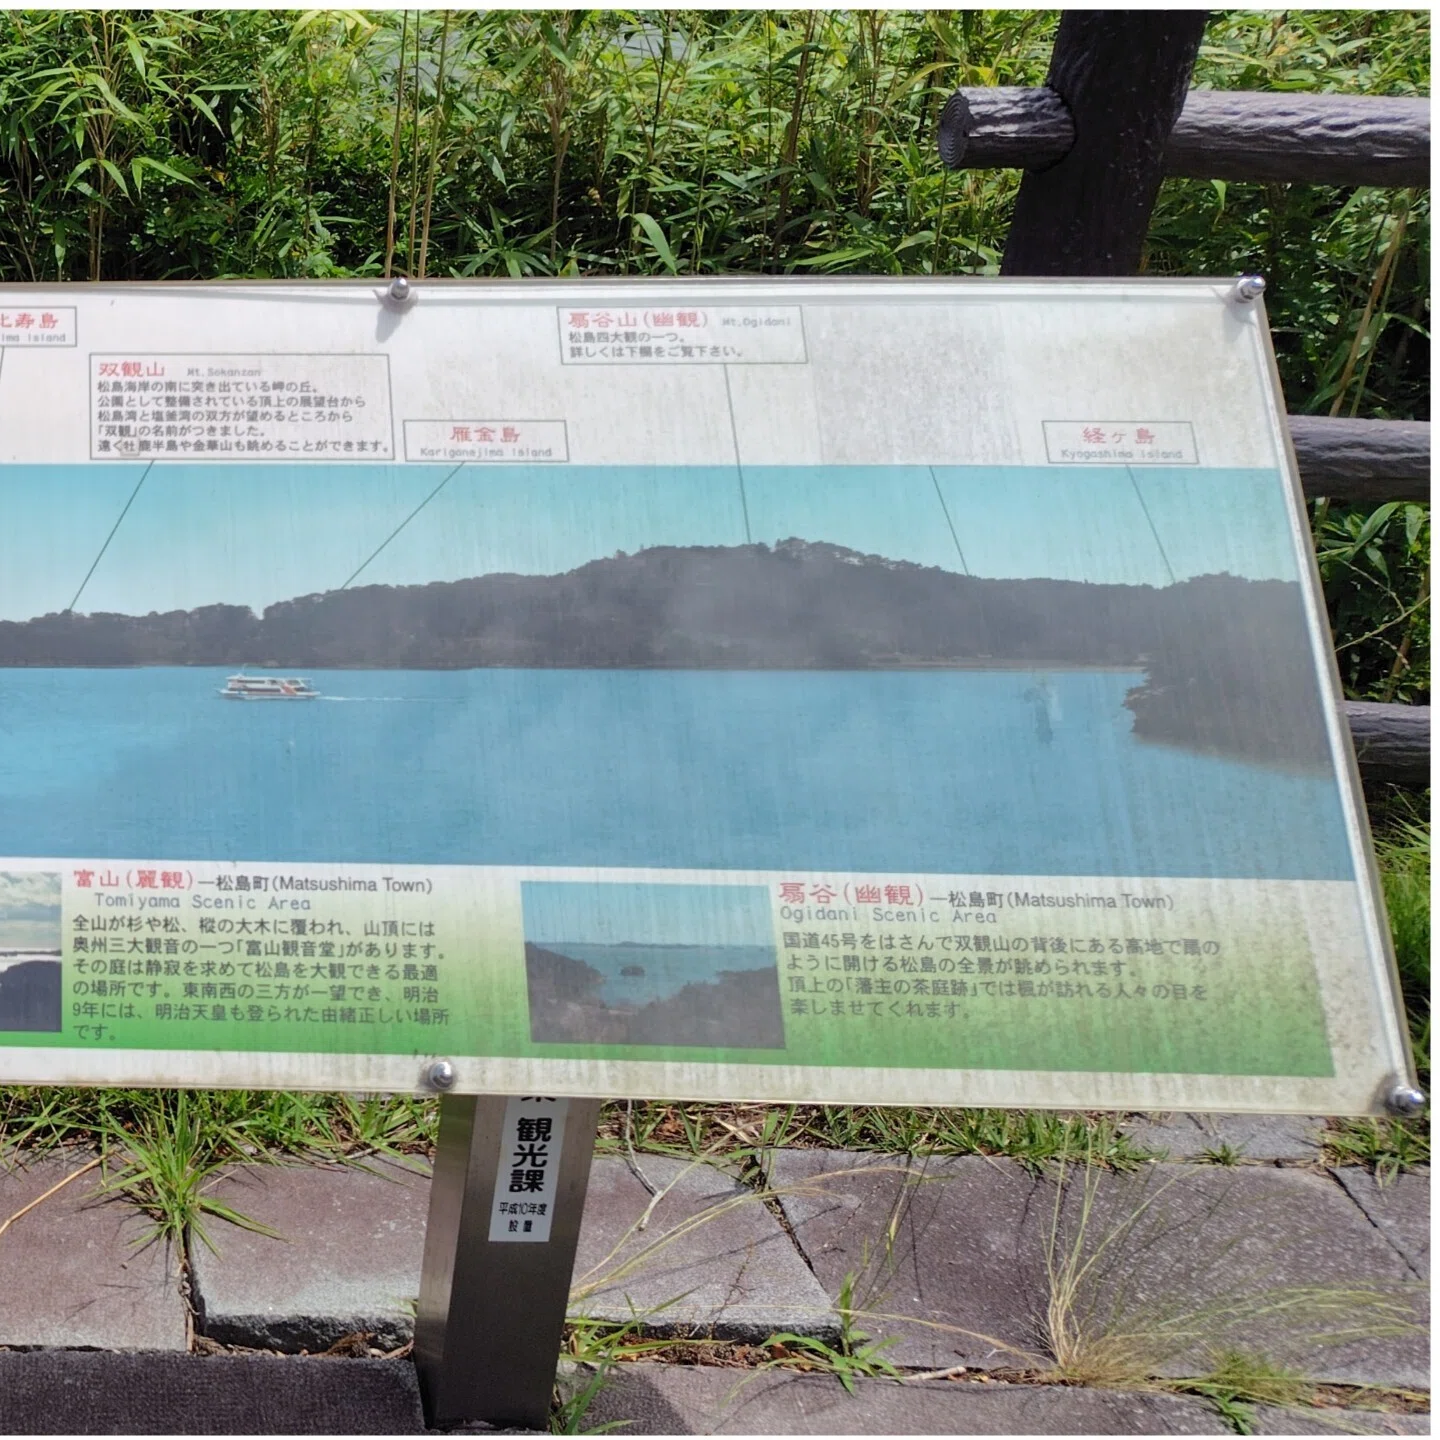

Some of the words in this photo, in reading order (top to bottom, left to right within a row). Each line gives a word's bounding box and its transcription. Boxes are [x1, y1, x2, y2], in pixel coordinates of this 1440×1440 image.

[569, 332, 686, 344] 松島四大観の一つ。
[570, 346, 744, 358] 詳しくは下欄をご覧下さい。
[98, 362, 166, 377] 双観山
[98, 381, 317, 393] 松島海岸の南に突き出ている岬の丘。
[98, 396, 366, 408] 公園として整備されている頂上の展望台から
[450, 427, 520, 444] 雁金島
[95, 892, 180, 910] Tomiyama
[192, 894, 256, 910] Scenic
[268, 896, 311, 911] Area
[781, 907, 860, 924] Ogidani
[873, 907, 940, 923] Scenic
[953, 909, 997, 924] Area
[72, 937, 446, 960] 奥州三大観音の一つ「富山観音堂」があります。
[73, 959, 439, 981] その庭は静寂を求めて松島を大観できる最適
[73, 981, 439, 1003] の場所です。東南西の三方が一望でき、明治
[73, 1002, 449, 1025] 9年には、明治天皇も登られた由緒正しい場所
[73, 1025, 117, 1041] です。
[509, 1117, 553, 1192] 観光課
